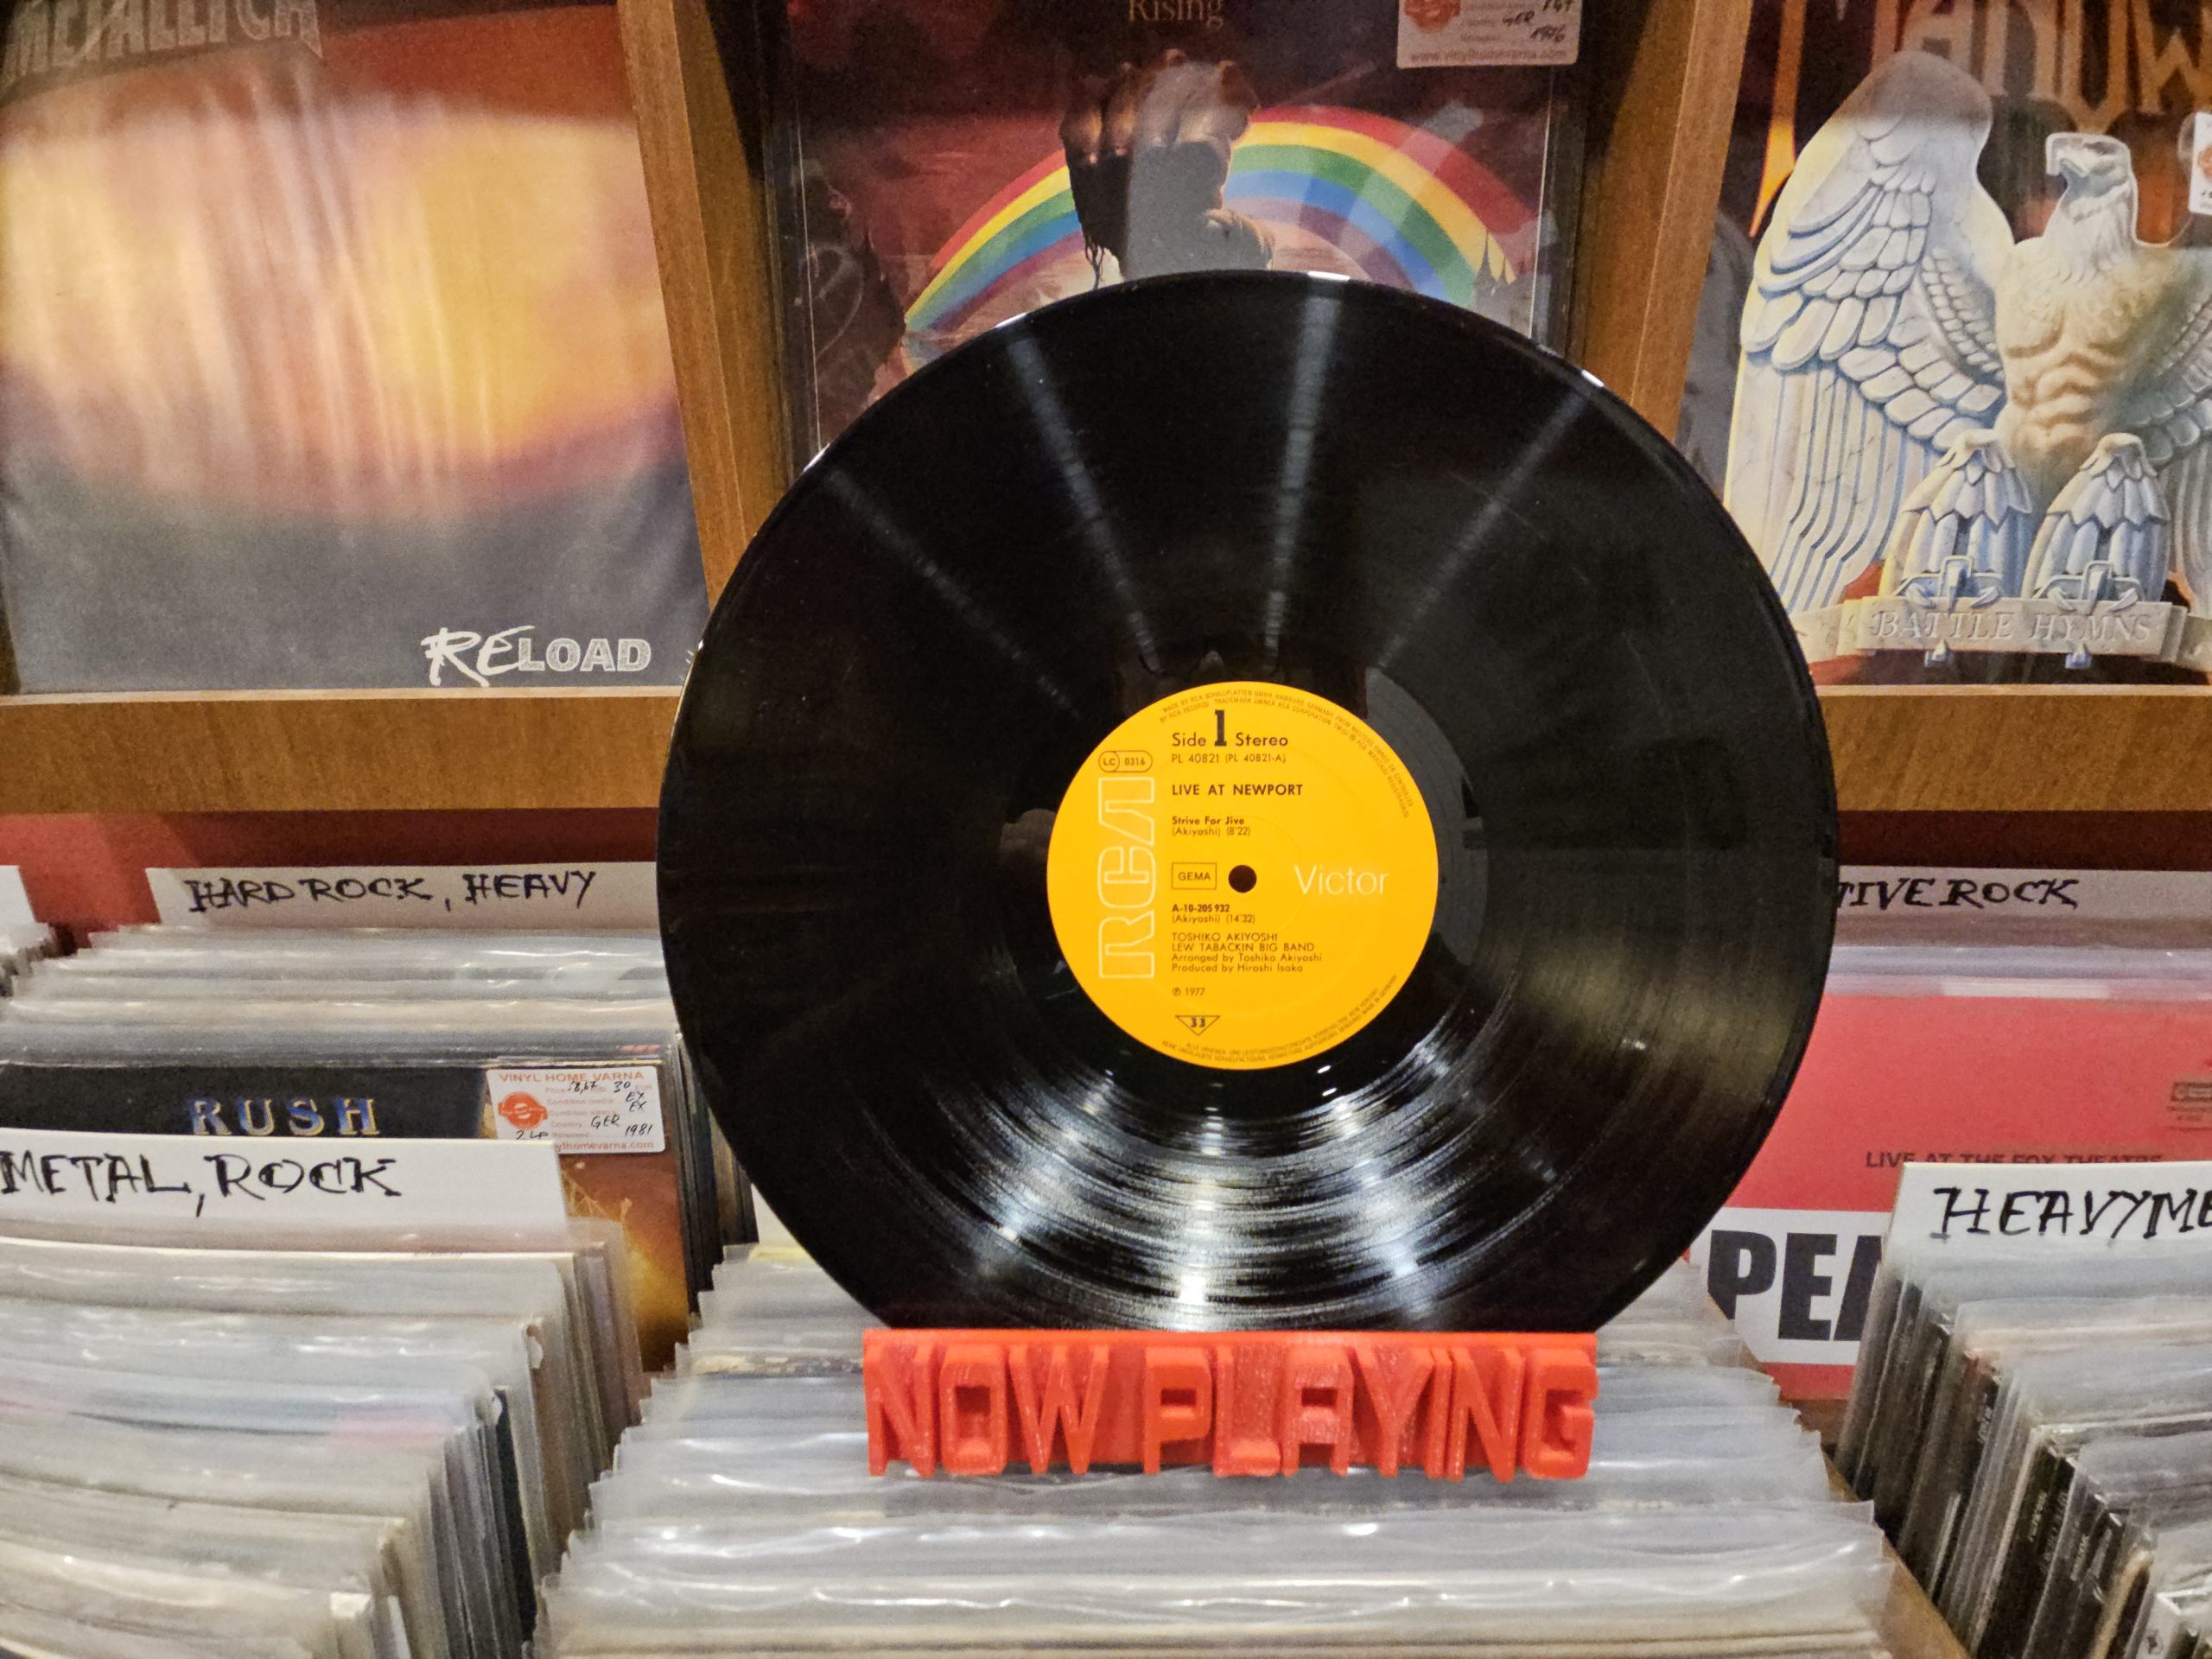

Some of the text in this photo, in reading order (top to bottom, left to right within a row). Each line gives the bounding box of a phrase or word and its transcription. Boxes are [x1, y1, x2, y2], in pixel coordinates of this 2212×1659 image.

[1871, 610, 2153, 643] BATTLE HYMNS
[422, 626, 652, 687] RELOAD
[1173, 709, 1288, 747] Side 1 Stereo
[1124, 758, 1146, 766] 0316
[1172, 753, 1286, 764] PL 40821 (PL 40821-A)
[1172, 784, 1303, 796] LIVE AT NEWPORT
[1172, 816, 1244, 825] Strive For Jive
[1172, 827, 1221, 836] (Akiyoshi)
[1097, 777, 1156, 979] RCA
[1178, 872, 1211, 881] GEMA
[1294, 865, 1389, 895] Victor
[183, 875, 296, 913] HARD
[461, 870, 596, 909] HEAVY
[1939, 878, 2080, 908] ROCK
[1172, 914, 1220, 924] (Akiyoshi)
[1172, 932, 1278, 941] TOSHIKO AKIYOSHI
[1172, 943, 1314, 951] LEW TABACKIN BIG BAND
[1172, 953, 1322, 963] Arranged by Toshiko Akiyoshi
[1172, 963, 1303, 973] Produced by Hiroshi Isaka
[1185, 988, 1205, 996] 1977
[499, 1071, 645, 1083] VINYL HOME VARNA
[613, 1081, 631, 1093] 30
[626, 1091, 645, 1103] EX
[629, 1101, 647, 1112] EX
[191, 1097, 381, 1137] RUSH
[625, 1124, 653, 1137] 1981
[1866, 1152, 1916, 1168] LIVE
[204, 1153, 402, 1200] ROCK
[864, 1344, 1599, 1483] NOW PLAYING
